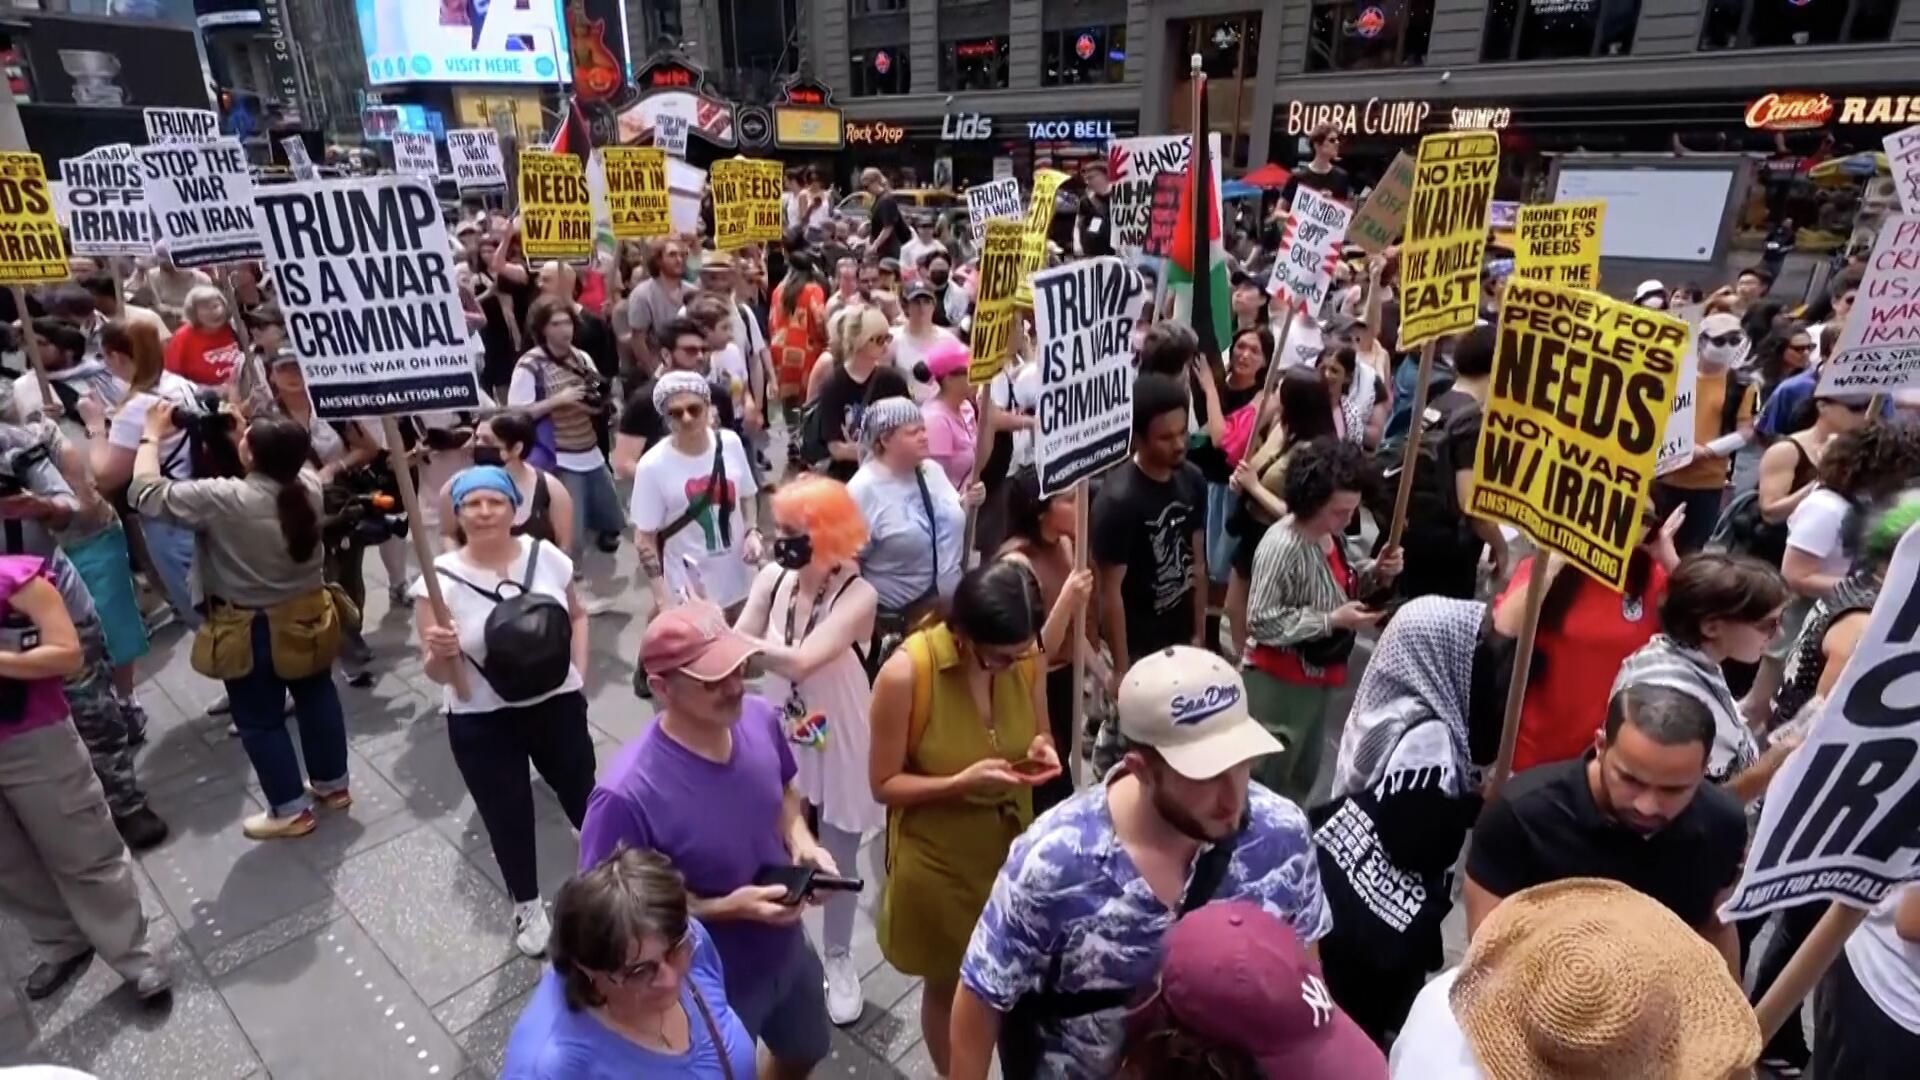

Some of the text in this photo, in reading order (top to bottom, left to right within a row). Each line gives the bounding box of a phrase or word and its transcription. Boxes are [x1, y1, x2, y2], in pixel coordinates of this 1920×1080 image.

[146, 111, 215, 137] TRUMP
[1287, 99, 1358, 136] BUBBA
[1363, 96, 1430, 135] GUMP
[1744, 93, 1833, 128] Cane's
[449, 132, 496, 147] STOP THE
[846, 123, 871, 142] Rock
[874, 121, 904, 145] Shop
[941, 111, 993, 141] Lids
[1027, 120, 1116, 139] TACO BELL
[141, 148, 245, 180] STOP THE
[463, 146, 489, 161] WAR
[1133, 136, 1193, 176] HANDS
[64, 162, 142, 188] HANDS
[457, 163, 501, 177] ON IRAN
[606, 169, 665, 192] WAR IN
[1416, 164, 1449, 187] NO
[1453, 159, 1497, 183] NEW
[68, 188, 144, 206] OFF
[173, 175, 228, 204] WAR
[523, 173, 589, 205] NEEDS
[610, 196, 625, 209] THE
[969, 180, 1017, 209] TRUMP
[165, 205, 254, 237] ON IRAN
[253, 185, 436, 260] TRUMP
[612, 210, 667, 224] EAST
[971, 200, 1019, 222] IS A WAR
[1522, 206, 1598, 222] MONEY FOR
[71, 210, 151, 242] IRAN!
[525, 219, 552, 240] W/
[558, 219, 591, 240] IRAN
[1521, 221, 1596, 241] PEOPLE'S
[1530, 239, 1581, 256] NEEDS
[274, 252, 451, 306] IS A WAR
[1406, 250, 1431, 283] THE
[1520, 263, 1593, 282] NOT THE
[1035, 262, 1144, 340] TRUMP
[1404, 273, 1478, 316] EAST
[290, 301, 465, 357] CRIMINAL
[1505, 285, 1686, 347] MONEY FOR
[1042, 316, 1133, 387] IS A WAR
[1504, 305, 1675, 374] PEOPLE'S
[306, 354, 468, 377] STOP THE WAR ON IRAN
[319, 385, 470, 408] ANSWERCOALITION.ORG
[1039, 364, 1131, 437] CRIMINAL
[1494, 328, 1666, 457] NEEDS
[1064, 433, 1080, 444] THE
[1082, 425, 1100, 439] WAR
[1487, 410, 1556, 448] NOT
[1558, 441, 1643, 493] WAR
[1482, 434, 1637, 550] W/ IRAN
[1170, 695, 1207, 718] San
[1360, 858, 1422, 917] SUDAN
[1371, 849, 1427, 902] CONGO
[1782, 872, 1816, 895] FOR
